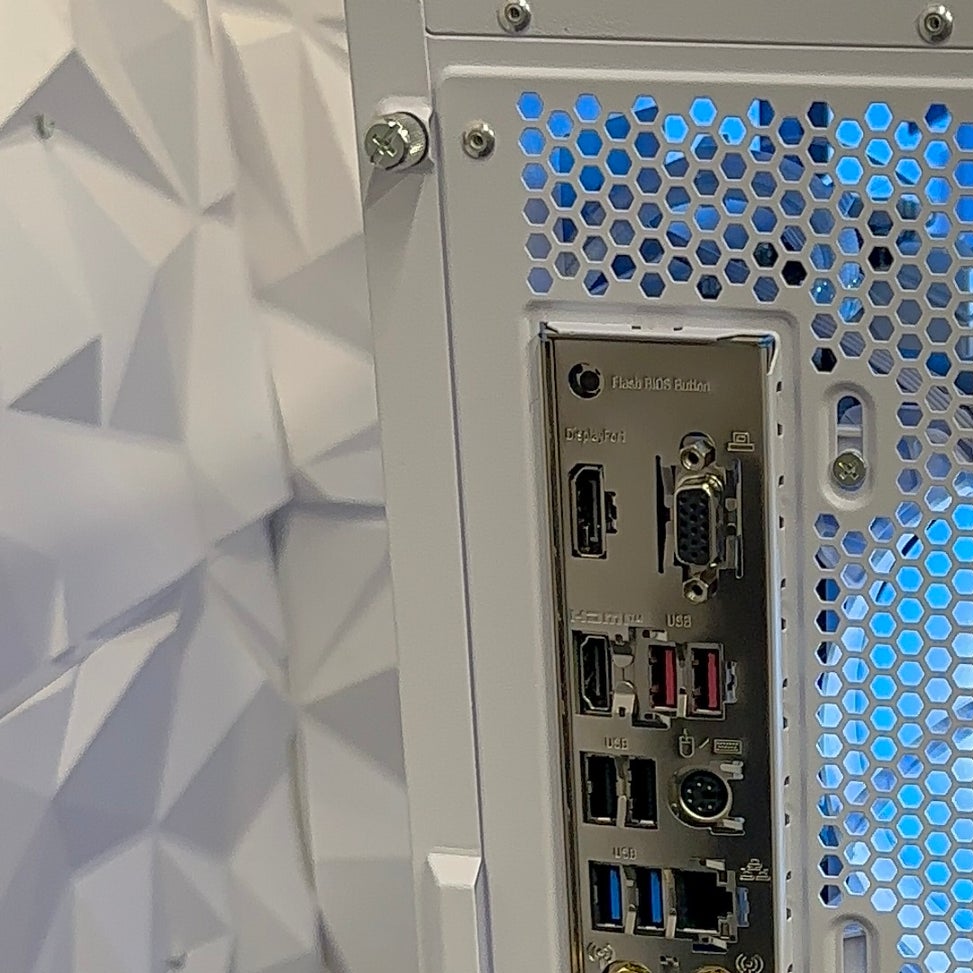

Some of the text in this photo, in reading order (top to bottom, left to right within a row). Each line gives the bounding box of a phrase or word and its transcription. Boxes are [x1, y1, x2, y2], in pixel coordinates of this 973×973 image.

[612, 375, 711, 392] Flash BIOS Button
[665, 613, 692, 629] USB
[604, 736, 630, 750] USB
[612, 846, 638, 860] USB
